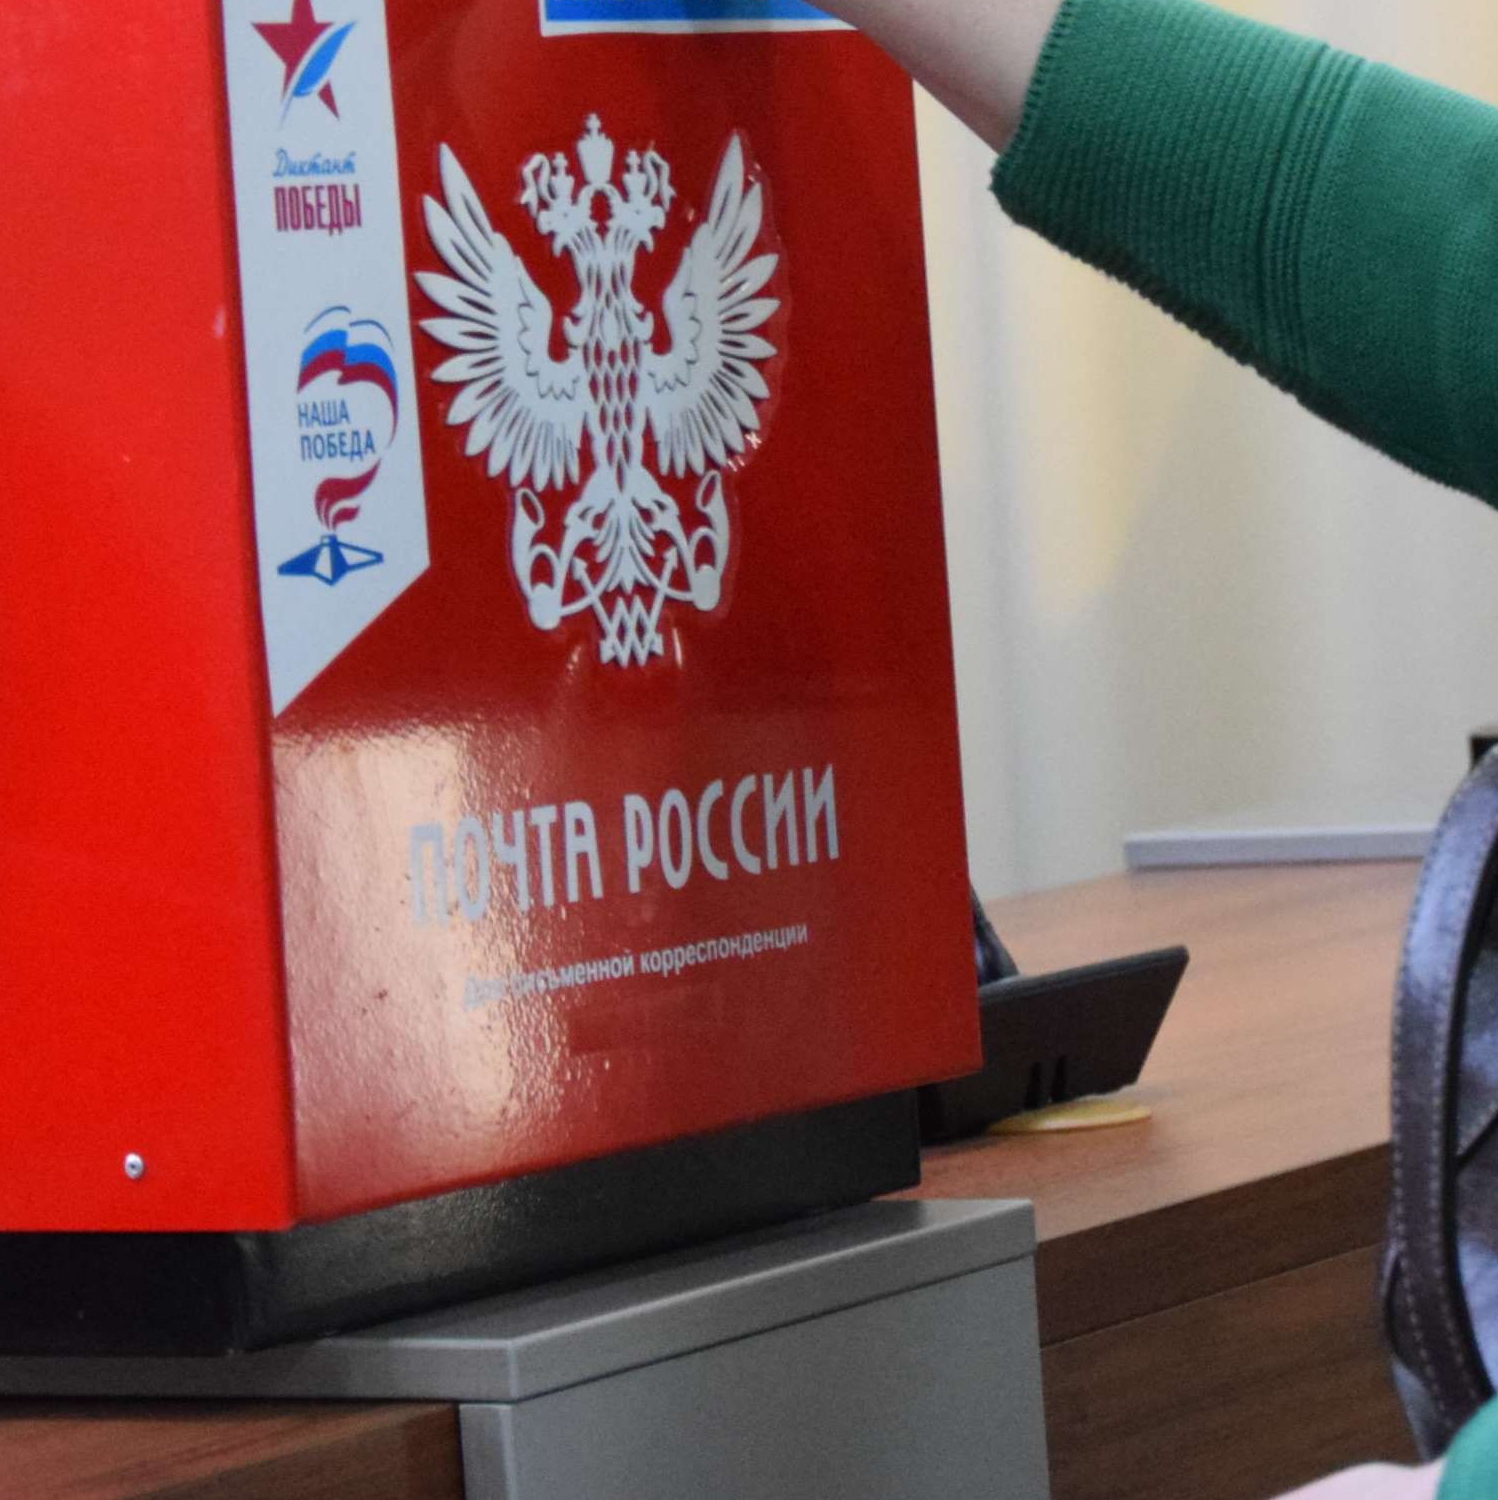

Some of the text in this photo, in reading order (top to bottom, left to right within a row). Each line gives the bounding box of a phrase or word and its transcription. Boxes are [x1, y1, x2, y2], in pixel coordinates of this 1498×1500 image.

[273, 148, 357, 178] Диктант
[274, 183, 363, 237] ПОБЕДЫ
[297, 399, 351, 428] НАША
[300, 429, 376, 462] ПОБЕДА
[409, 763, 841, 928] ПОЧТА РОССИИ
[639, 923, 809, 977] корреспонденции
